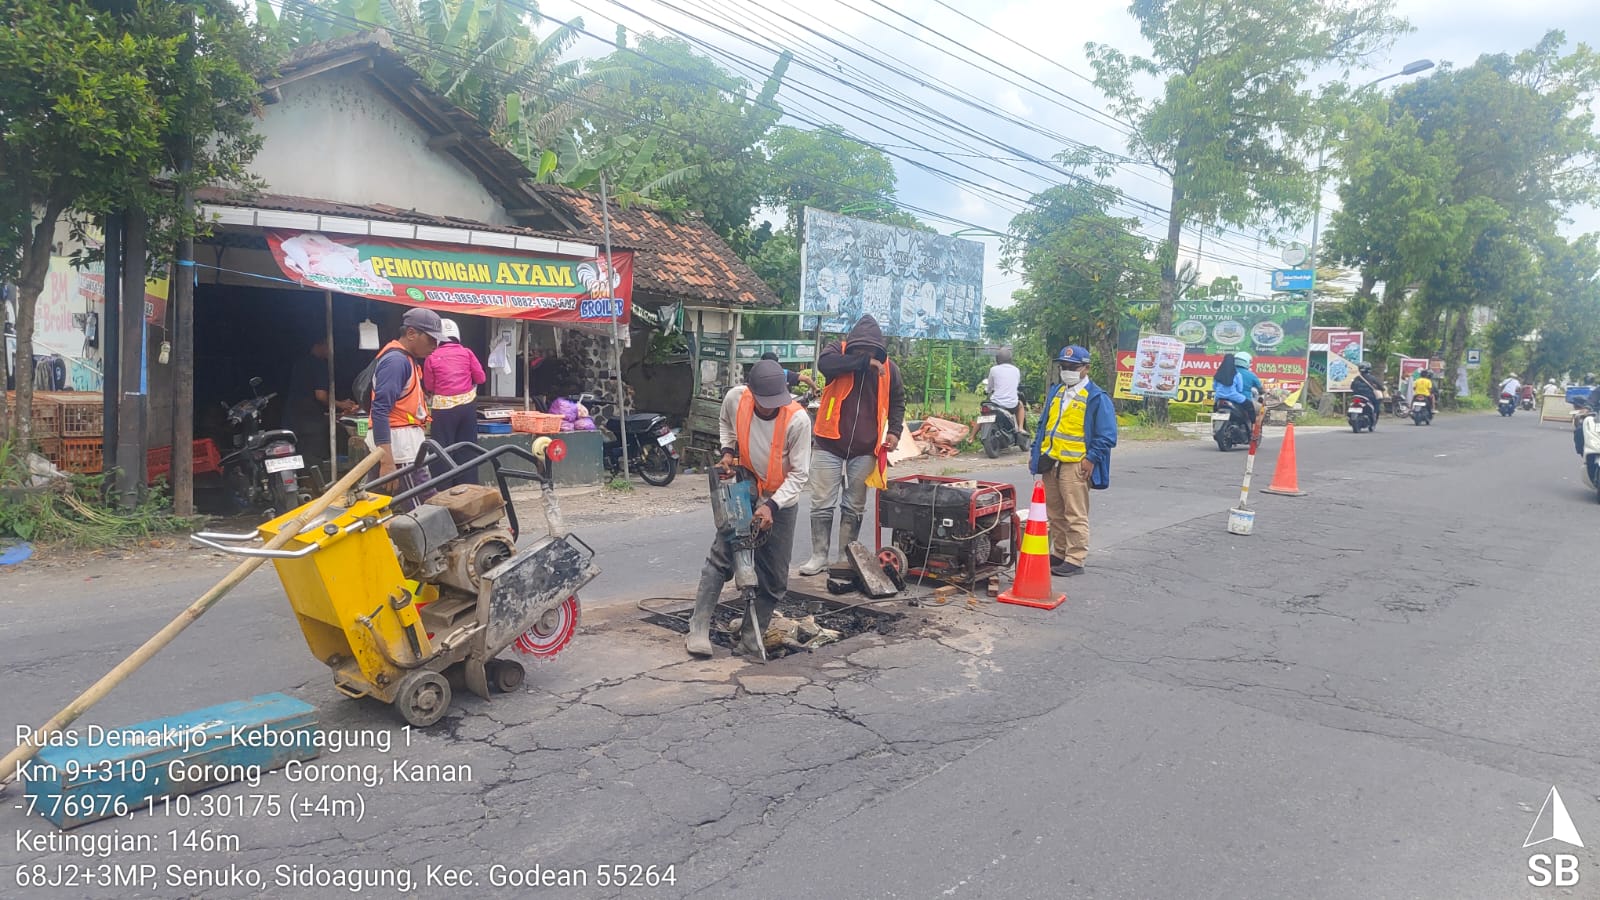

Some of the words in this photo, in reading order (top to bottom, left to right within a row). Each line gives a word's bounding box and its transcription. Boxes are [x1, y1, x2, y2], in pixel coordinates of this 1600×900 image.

[371, 256, 491, 283] PEMOTONGAN
[495, 262, 575, 287] AYAM
[50, 272, 69, 305] BM
[590, 280, 610, 299] BM
[43, 304, 73, 334] Broile
[1203, 303, 1242, 314] AGRO
[1244, 303, 1287, 315] JOGJA
[1215, 314, 1233, 322] TANI
